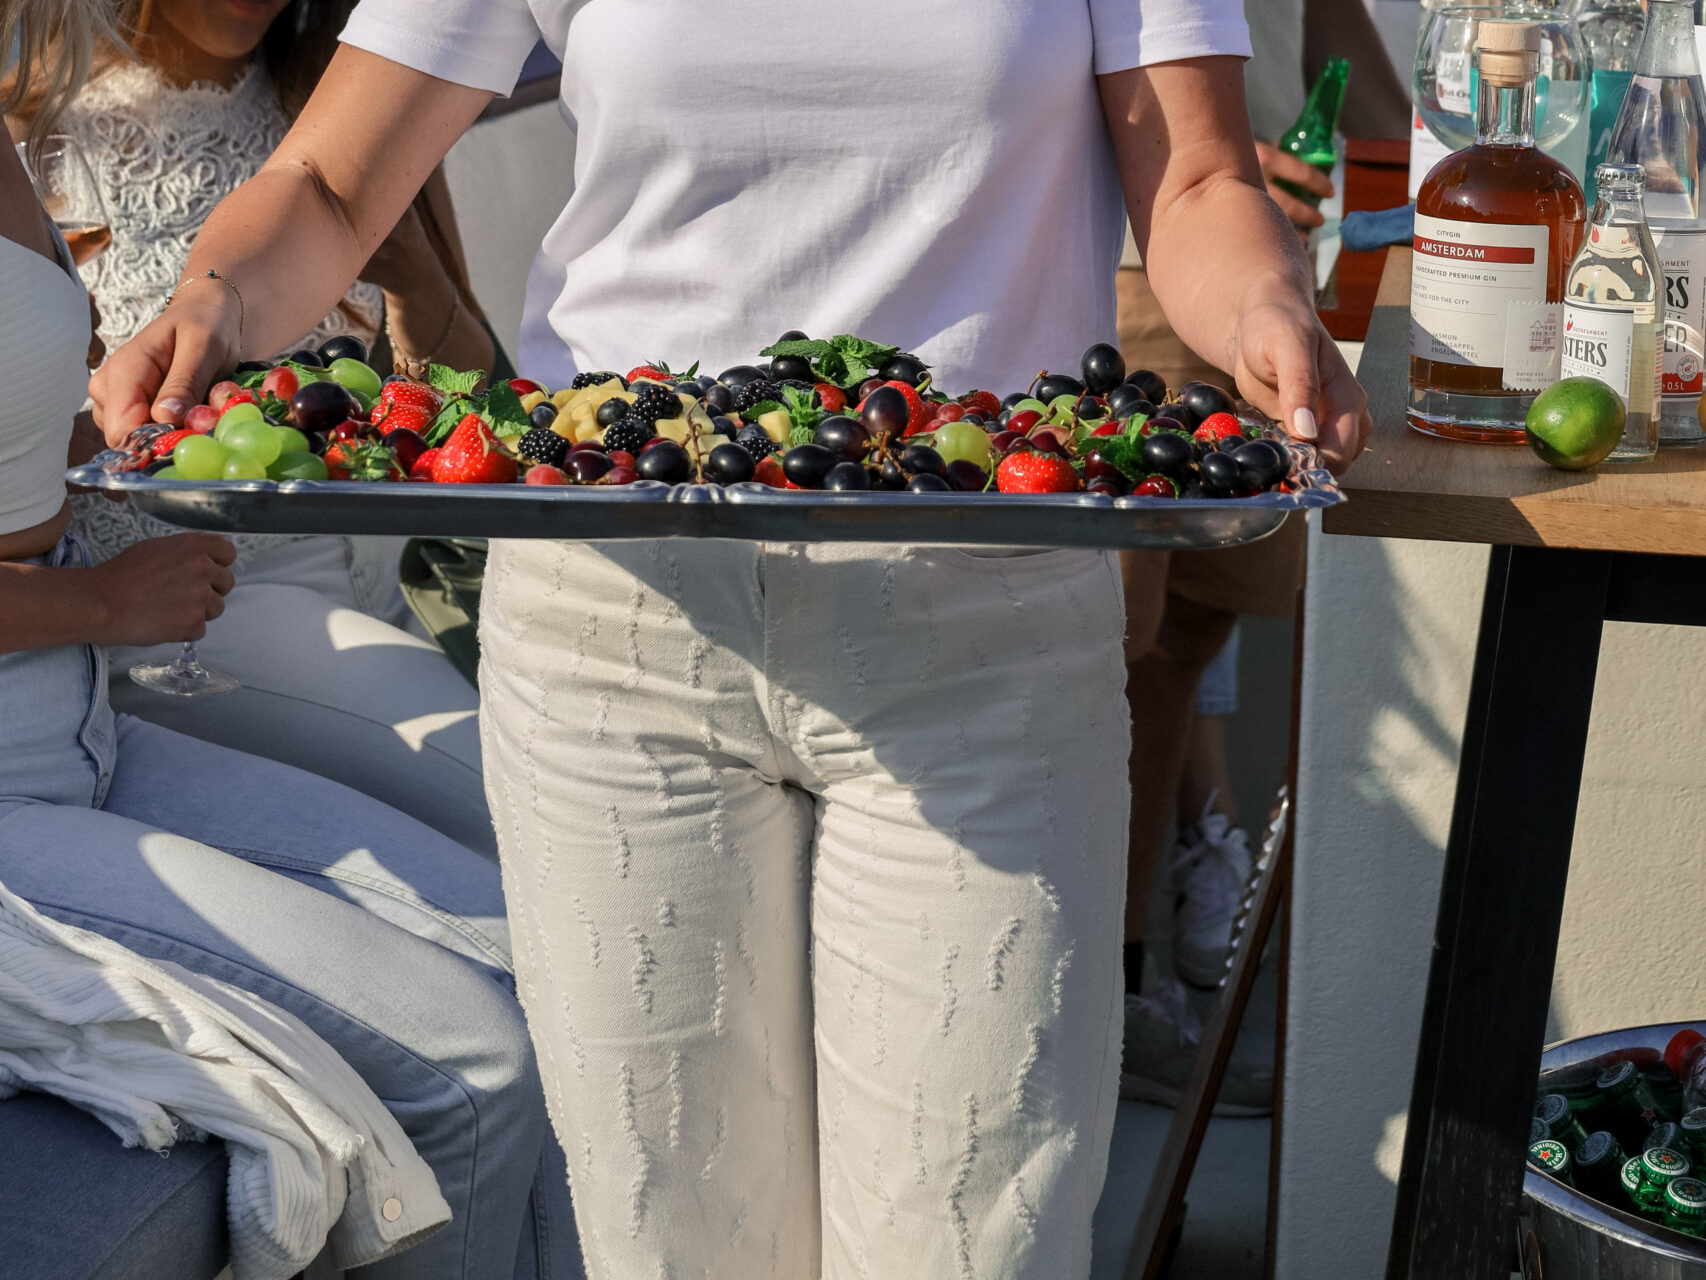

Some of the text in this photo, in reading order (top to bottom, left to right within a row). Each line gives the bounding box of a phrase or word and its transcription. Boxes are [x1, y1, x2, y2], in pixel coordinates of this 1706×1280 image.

[1436, 229, 1461, 238] CITYGIN
[1420, 240, 1485, 259] AMSTERDAM
[1448, 271, 1481, 281] PREMIUM
[1428, 294, 1440, 302] FOR
[1441, 296, 1453, 304] THE
[1454, 298, 1470, 306] CITY
[1431, 339, 1474, 351] SINAASAPPEL
[1431, 347, 1479, 359] ENGELWORTEL
